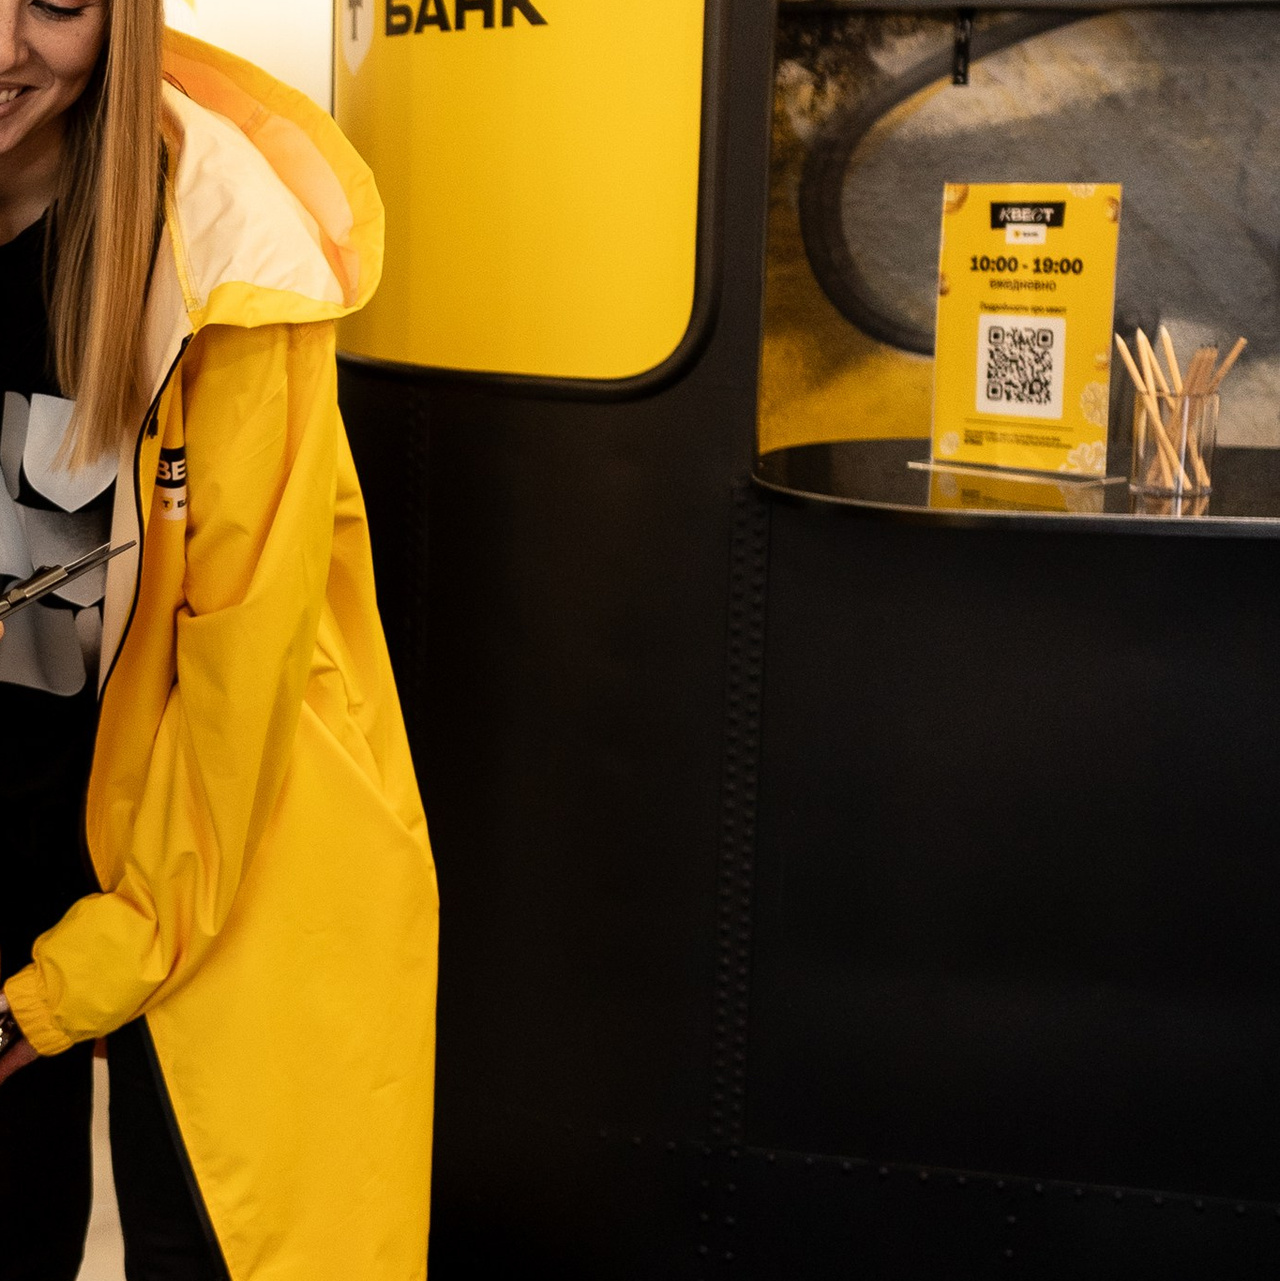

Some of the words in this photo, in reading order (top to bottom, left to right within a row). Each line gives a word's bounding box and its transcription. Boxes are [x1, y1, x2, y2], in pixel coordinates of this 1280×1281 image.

[1000, 207, 1055, 222] КВЕСТ
[970, 255, 1018, 272] 10:00
[1033, 258, 1083, 275] 19:00
